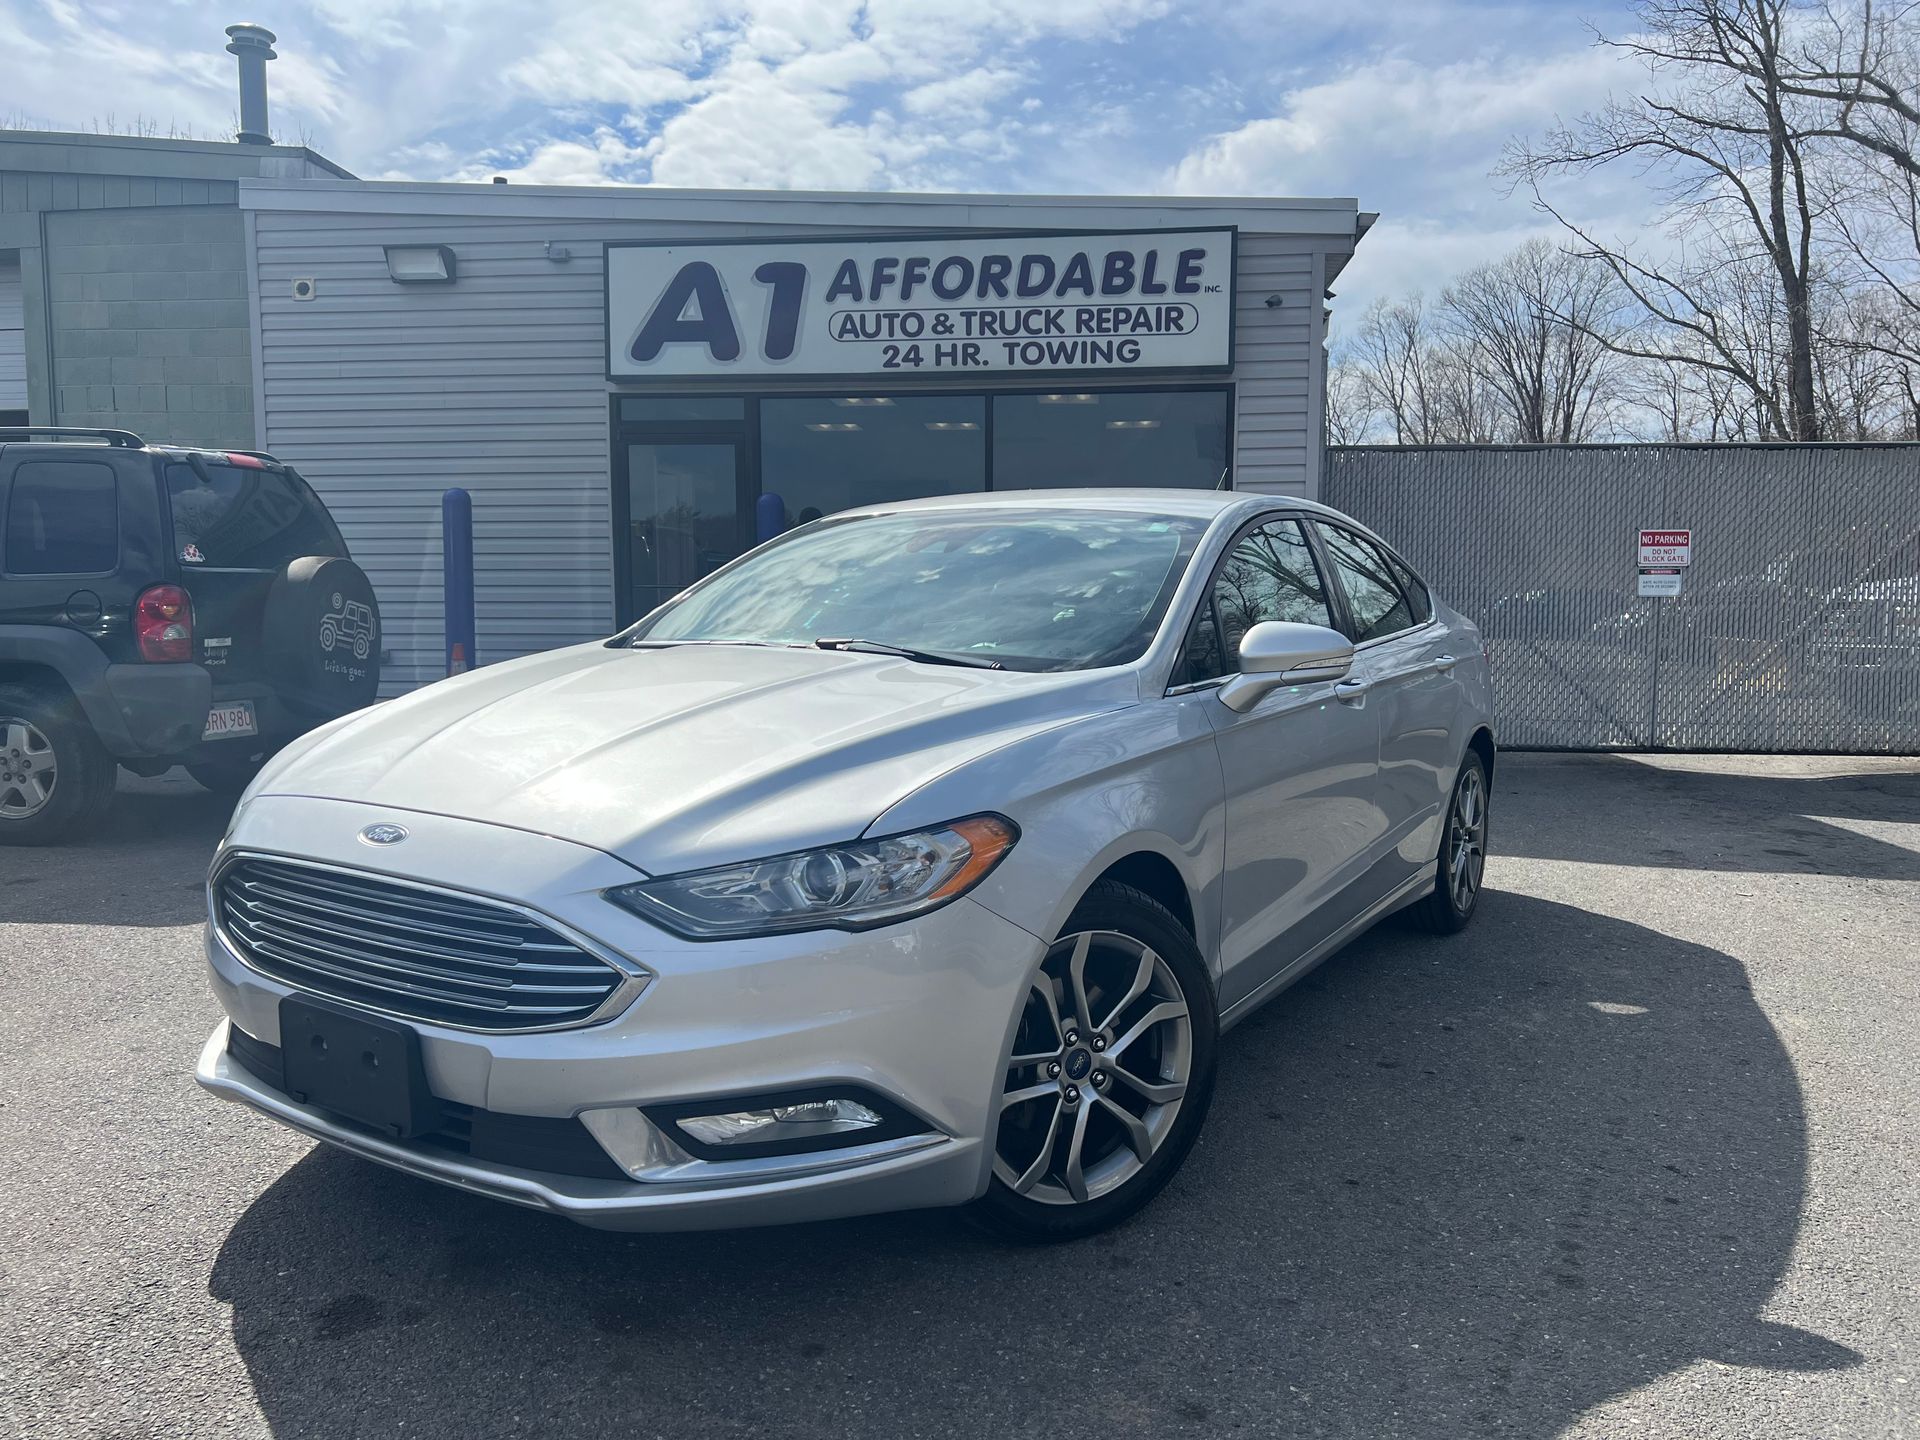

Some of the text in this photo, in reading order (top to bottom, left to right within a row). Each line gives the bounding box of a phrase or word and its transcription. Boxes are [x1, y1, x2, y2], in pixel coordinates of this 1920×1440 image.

[825, 248, 1206, 302] AFFORDABLE
[1204, 285, 1223, 293] INC.
[628, 260, 811, 363] A1
[838, 306, 1184, 339] AUTO & TRUCK REPAIR
[882, 339, 1141, 368] 24 HR. TOWING
[1642, 535, 1688, 544] NO PARKING
[230, 710, 252, 728] 980
[368, 826, 399, 842] Ford
